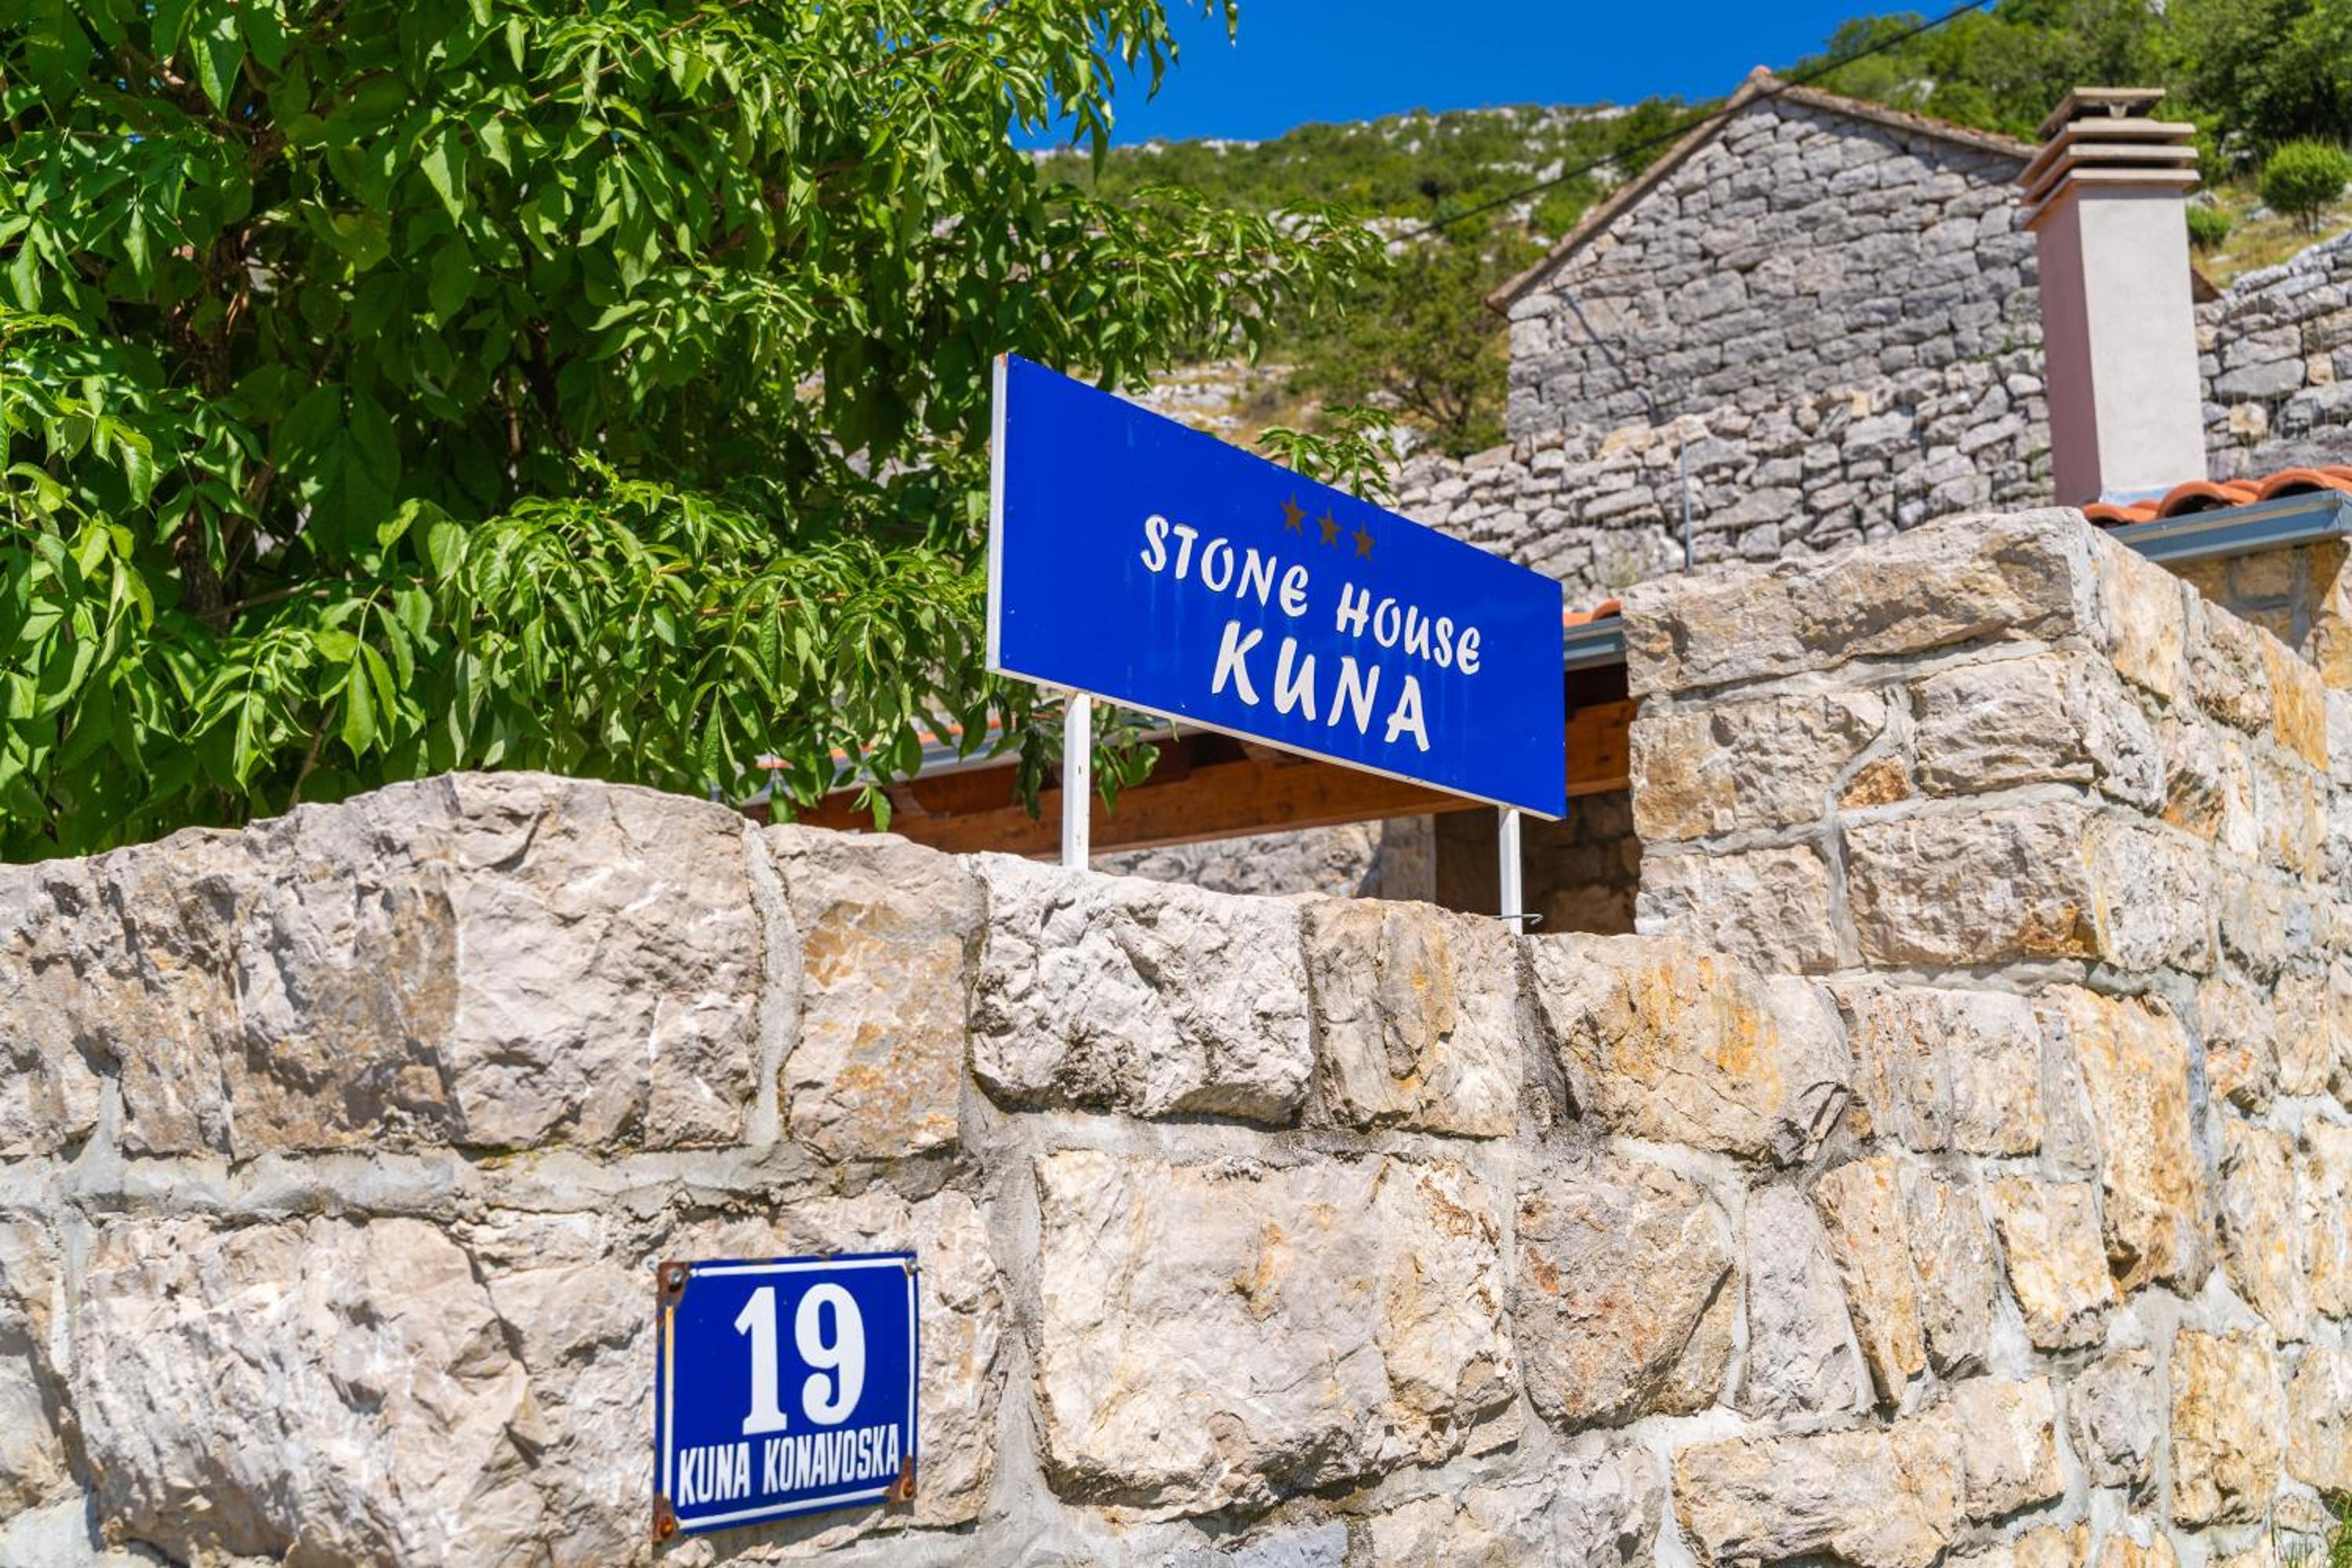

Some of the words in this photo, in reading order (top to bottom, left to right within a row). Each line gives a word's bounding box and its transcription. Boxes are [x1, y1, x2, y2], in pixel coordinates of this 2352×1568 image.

[1140, 514, 1309, 617] STONE
[1336, 582, 1482, 675] HOUSE
[1211, 620, 1430, 753] KUNA
[734, 1283, 866, 1436] 19
[677, 1442, 750, 1507] KUNA
[762, 1424, 899, 1495] KONAVOSKA
